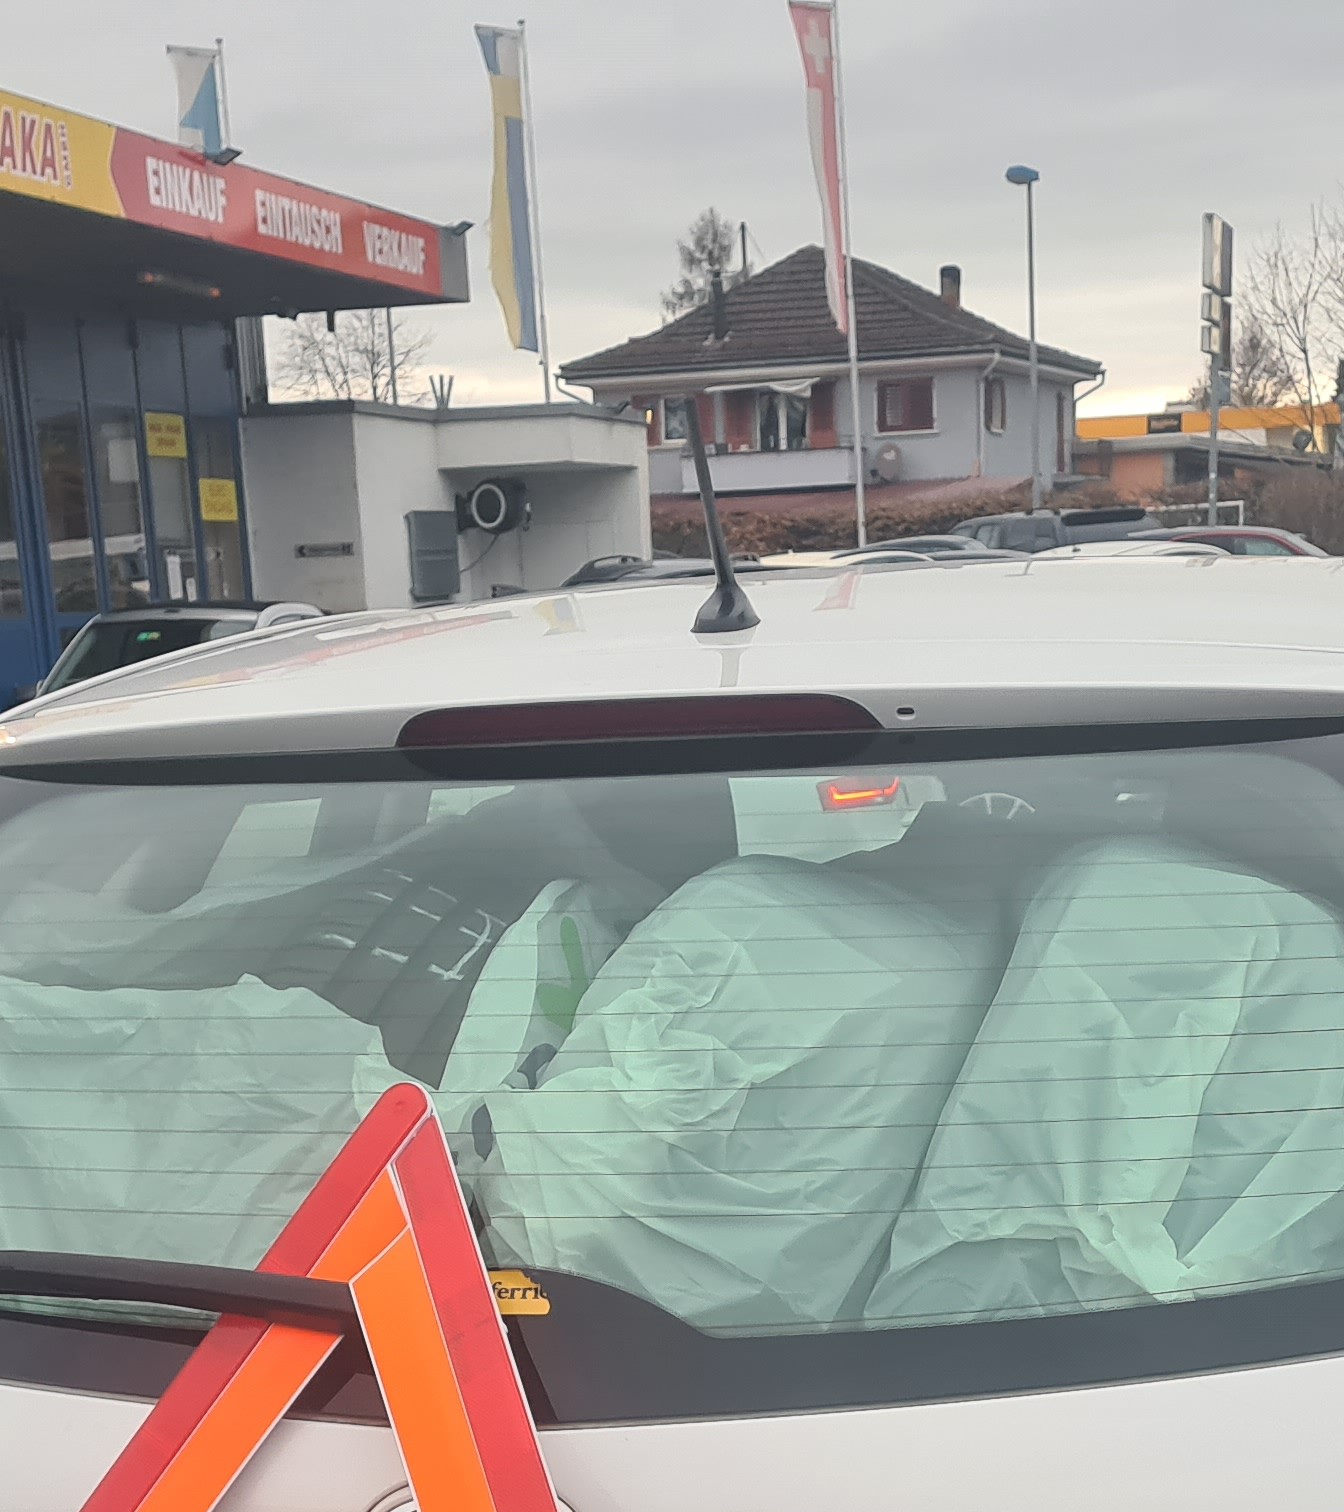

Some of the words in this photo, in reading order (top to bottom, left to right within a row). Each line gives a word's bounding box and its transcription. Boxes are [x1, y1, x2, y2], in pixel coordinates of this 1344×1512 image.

[146, 156, 227, 223] EINKAUF
[255, 188, 343, 254] EINTAUSCH
[363, 221, 426, 275] VERKAUF
